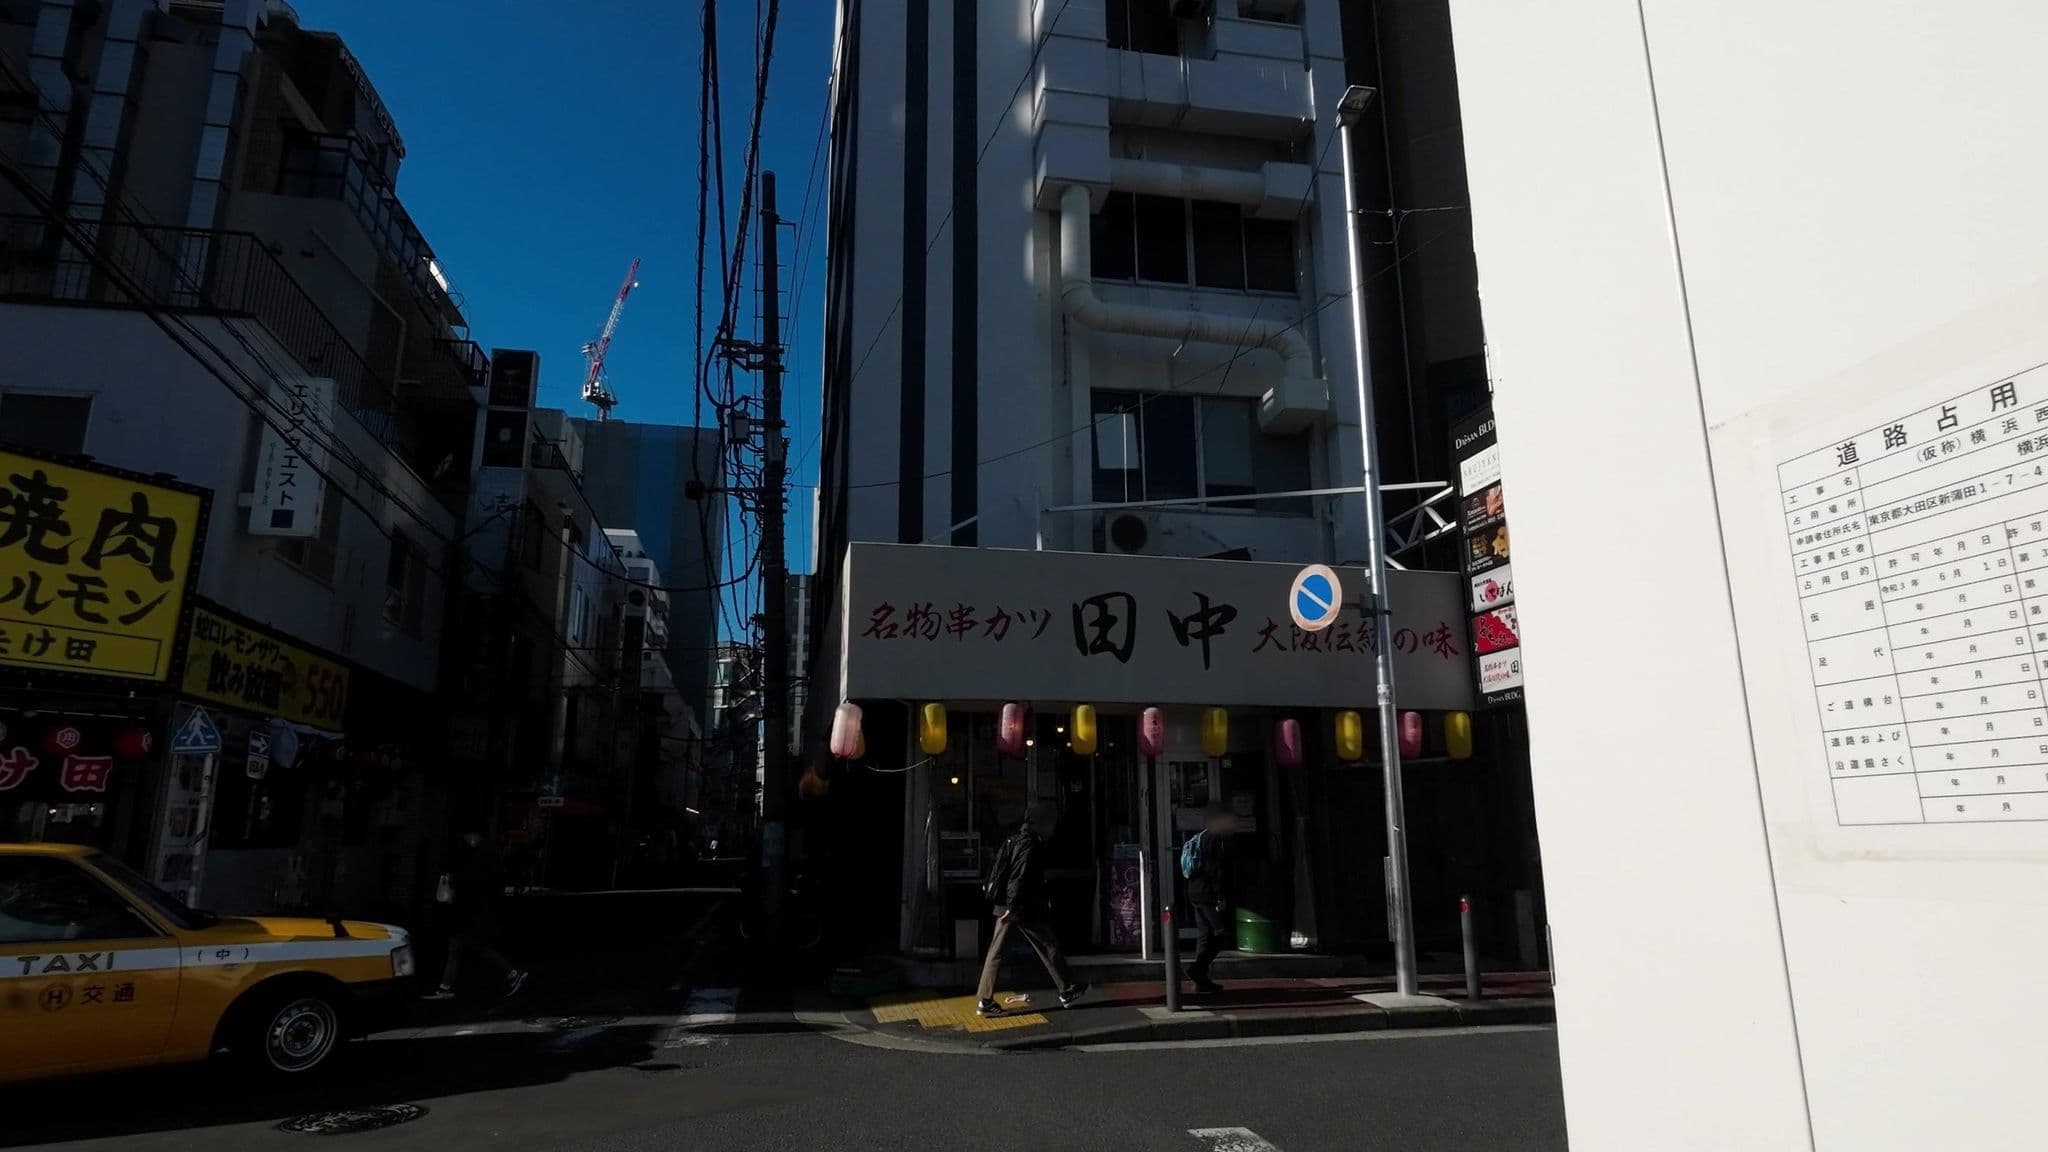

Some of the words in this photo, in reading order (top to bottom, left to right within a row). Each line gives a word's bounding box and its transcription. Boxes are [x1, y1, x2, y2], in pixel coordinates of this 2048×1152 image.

[0, 470, 176, 583] 焼肉
[862, 602, 1051, 641] 名物串カツ
[1072, 591, 1237, 670] 田中
[18, 952, 114, 975] TAXI
[80, 983, 134, 1005] 交通
